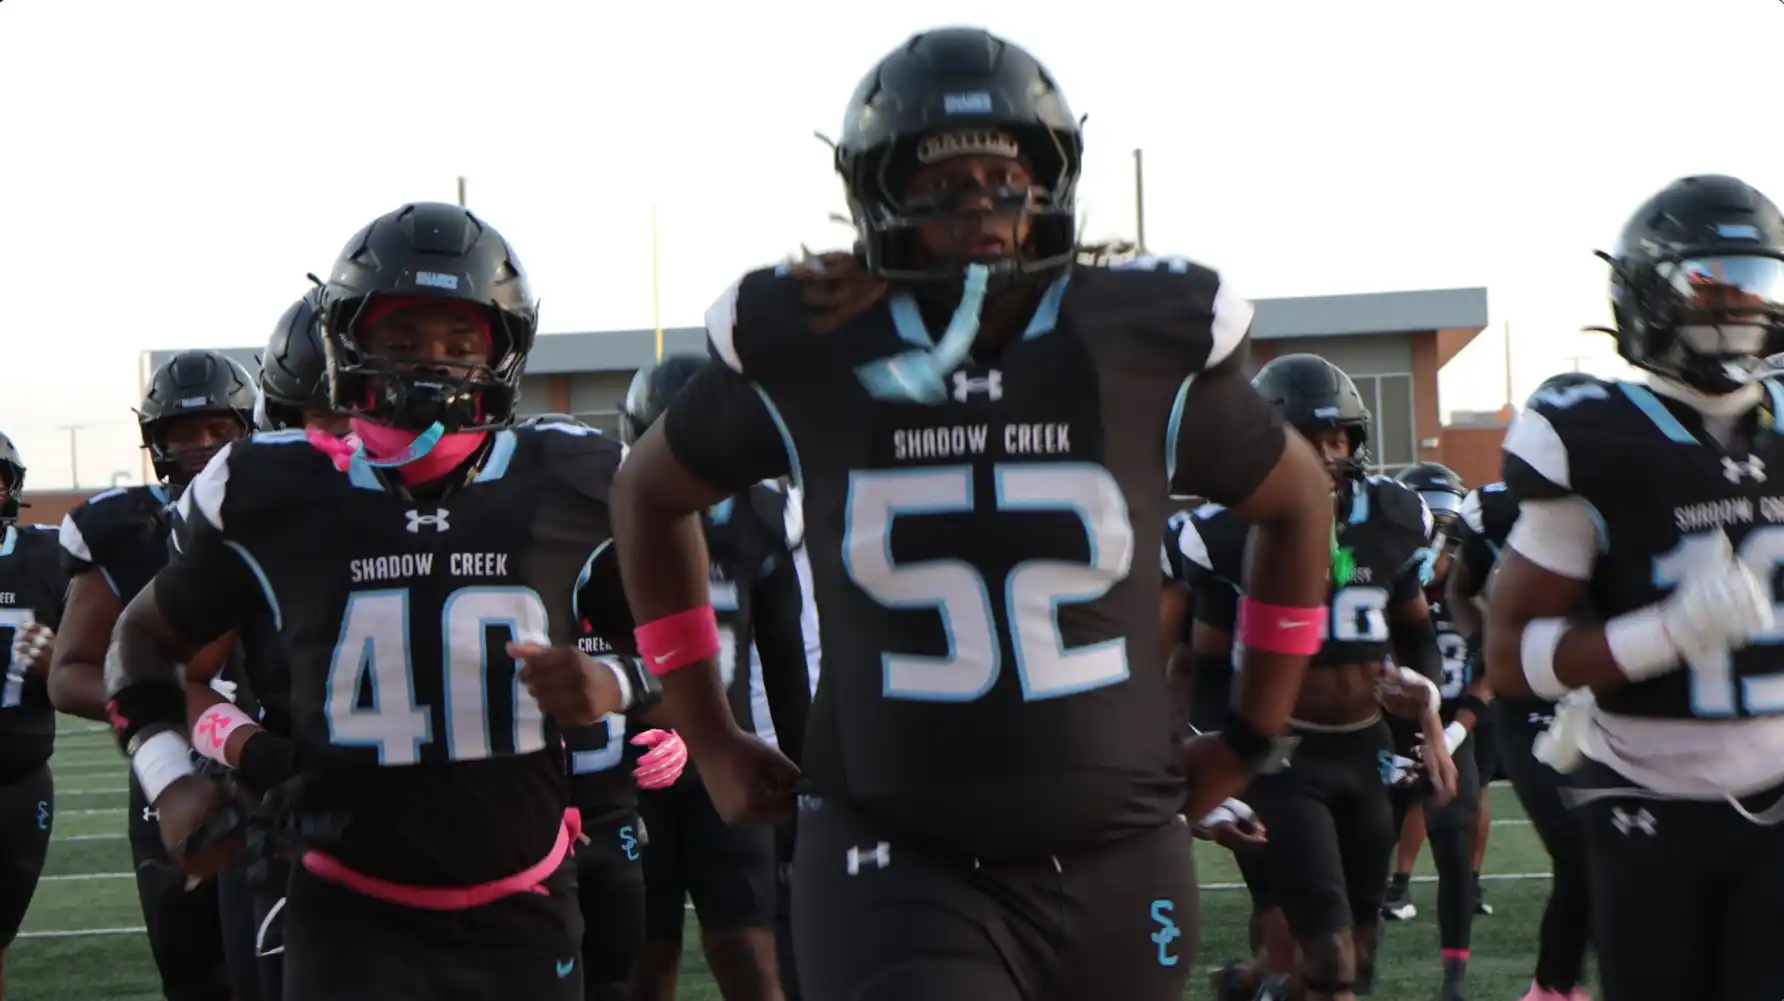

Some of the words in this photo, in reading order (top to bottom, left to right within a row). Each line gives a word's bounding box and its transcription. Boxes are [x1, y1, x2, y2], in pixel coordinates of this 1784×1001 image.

[893, 424, 988, 460] SHADOW
[1003, 423, 1071, 454] CREEK
[350, 552, 434, 583] SHADOW
[449, 552, 508, 577] CREEK
[841, 461, 1135, 702] 52
[324, 585, 552, 767] 40
